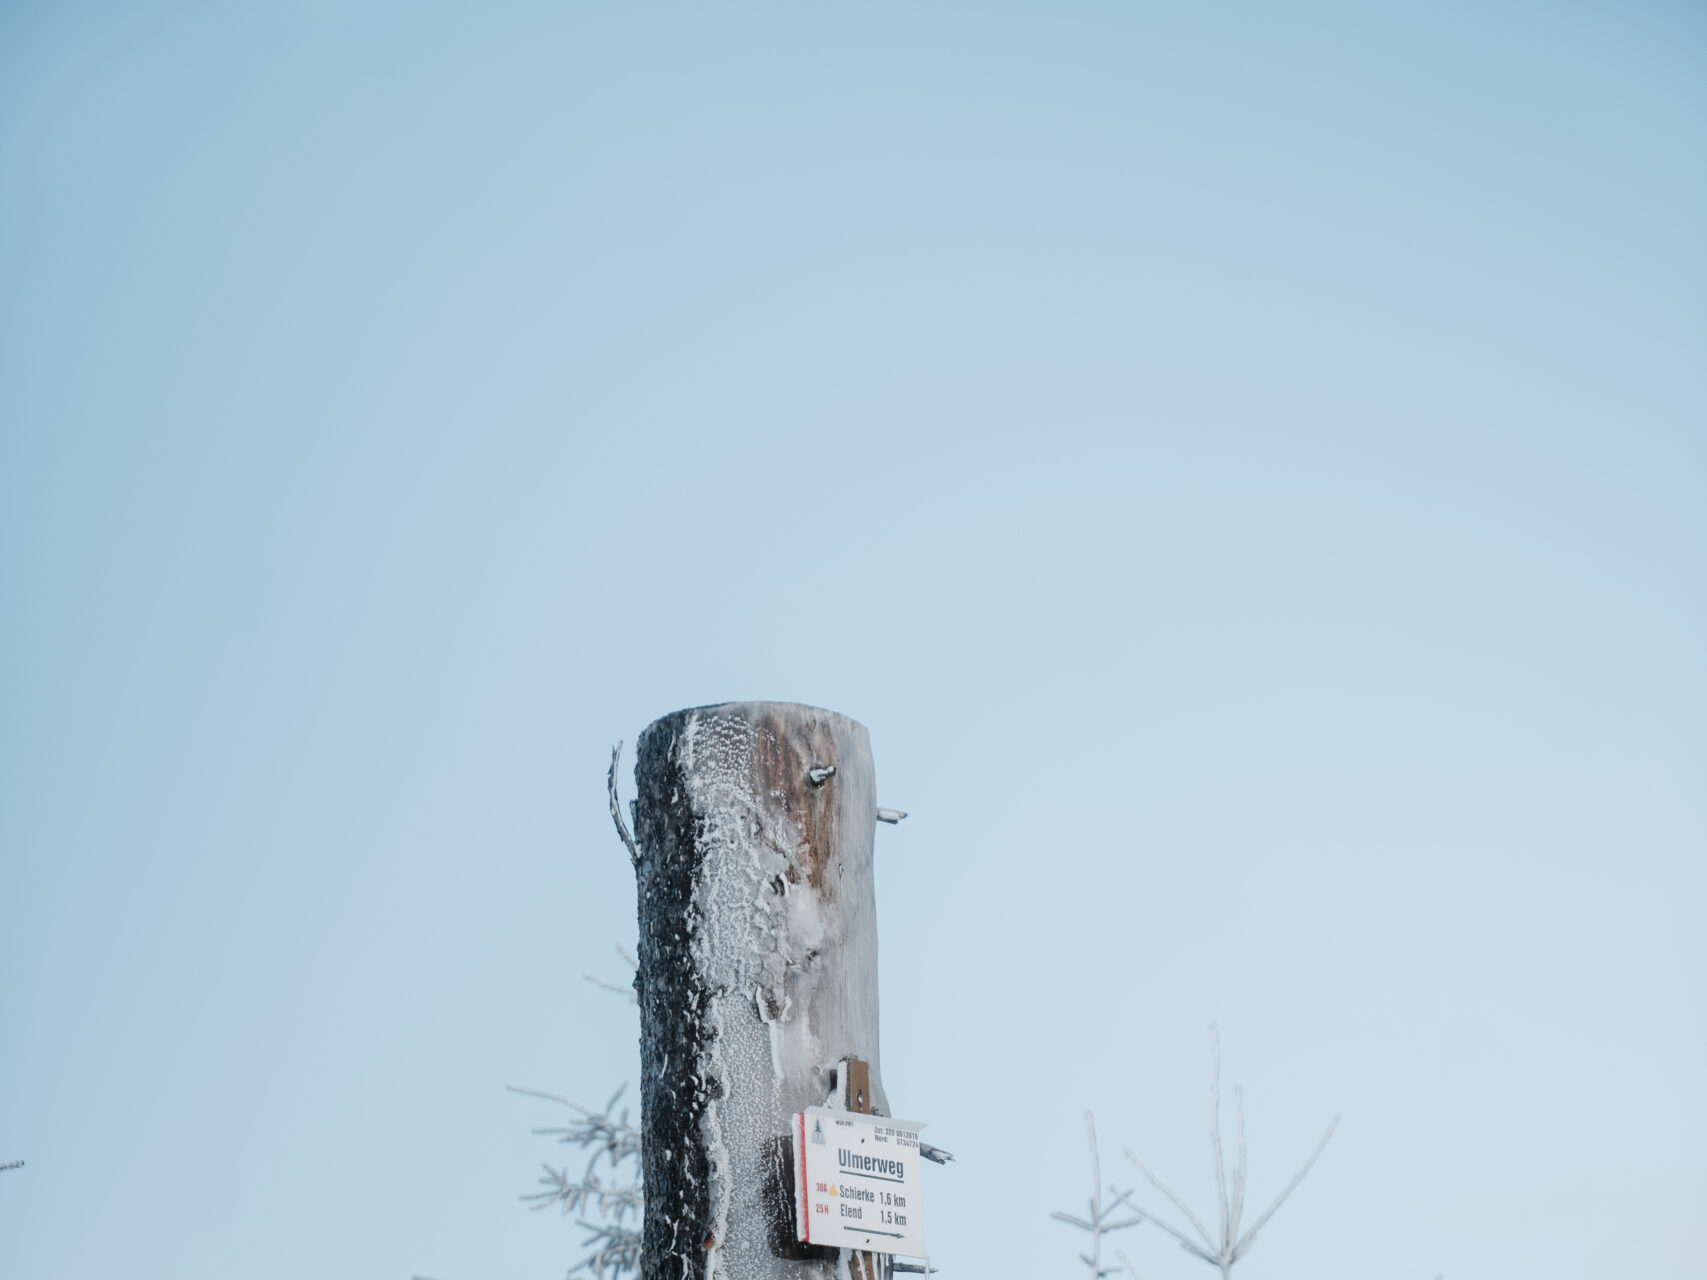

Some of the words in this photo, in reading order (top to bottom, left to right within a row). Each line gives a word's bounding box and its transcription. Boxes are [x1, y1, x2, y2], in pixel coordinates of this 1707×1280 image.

[838, 1148, 904, 1178] Ulmerweg
[816, 1183, 828, 1193] 30A
[839, 1184, 875, 1203] Schierke
[879, 1192, 892, 1206] 1,6
[893, 1194, 906, 1208] km
[840, 1203, 863, 1220] Elend
[880, 1210, 892, 1224] 1,5
[894, 1212, 907, 1227] km
